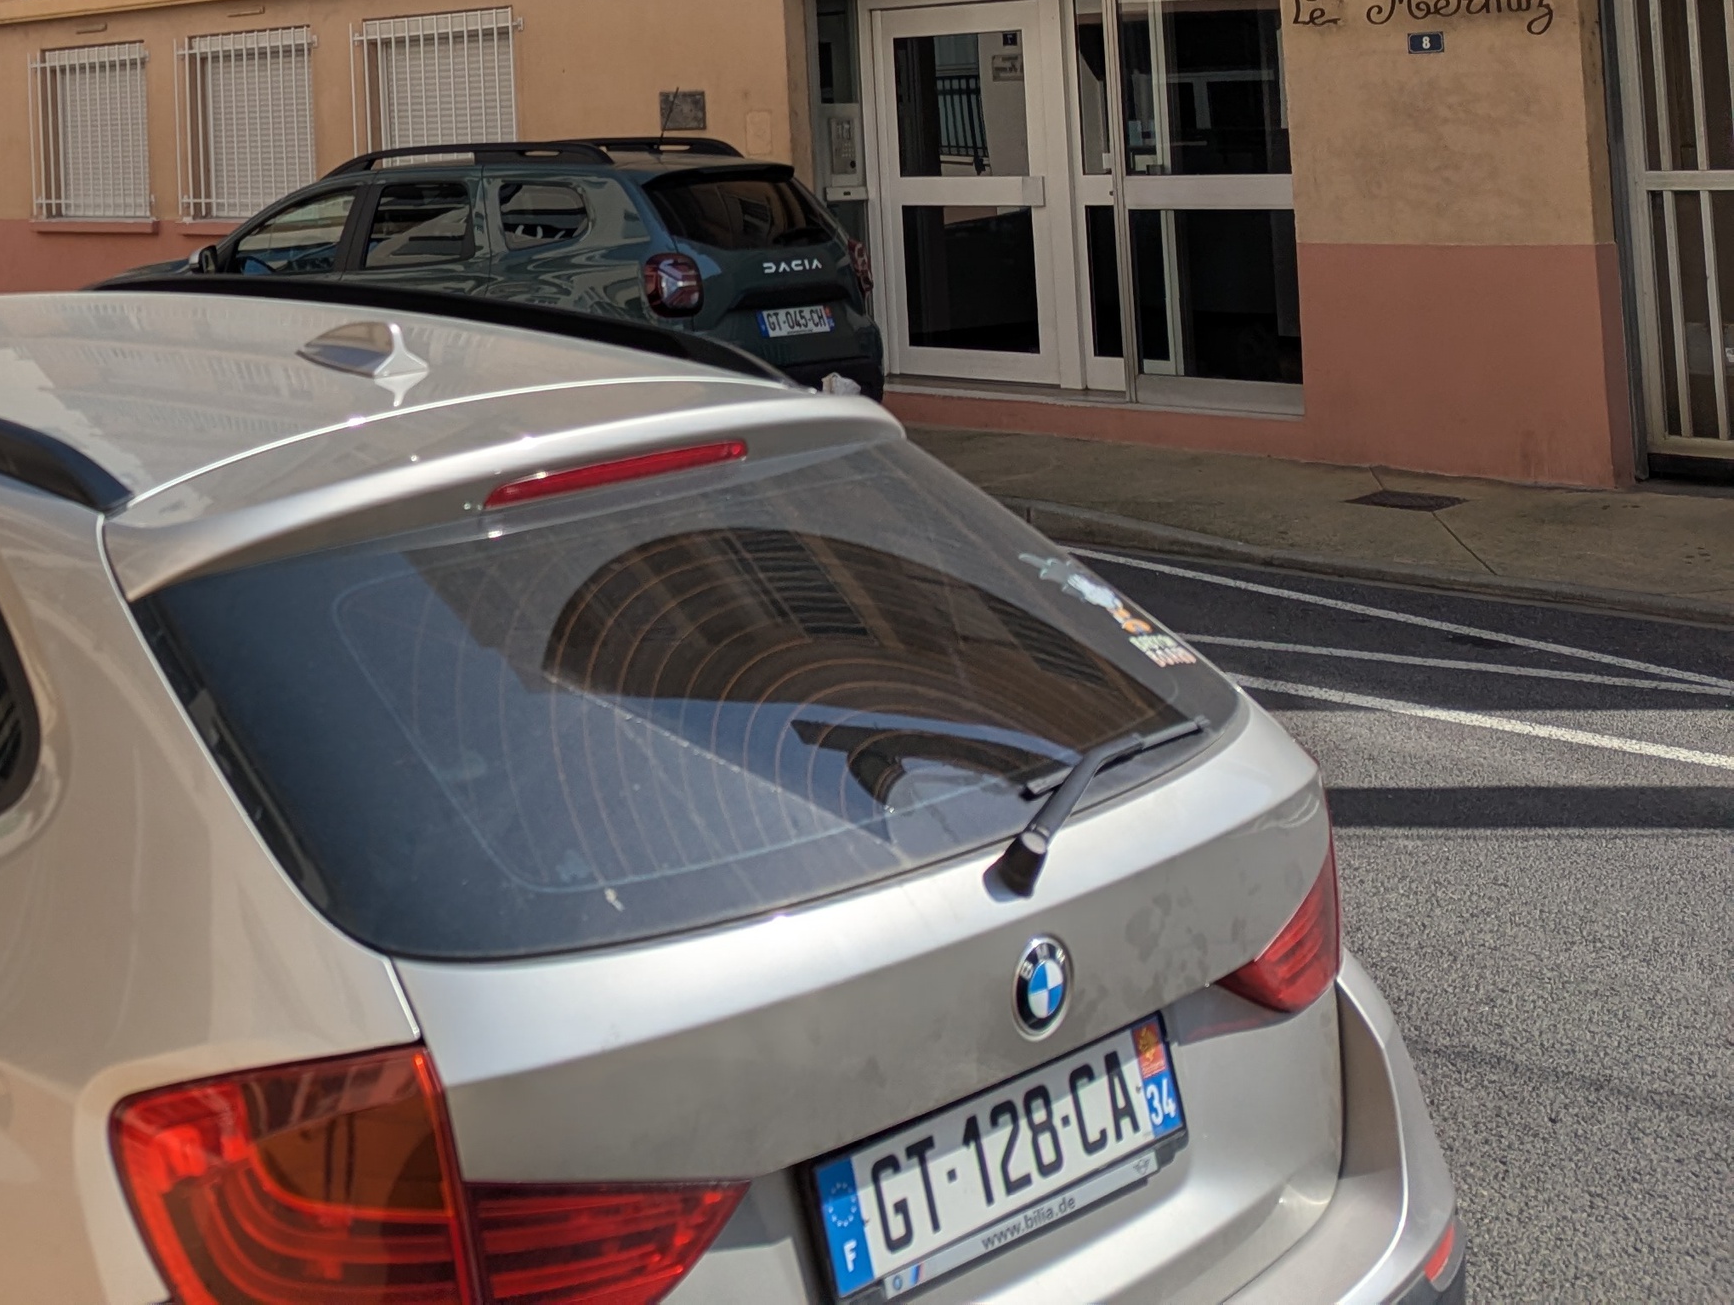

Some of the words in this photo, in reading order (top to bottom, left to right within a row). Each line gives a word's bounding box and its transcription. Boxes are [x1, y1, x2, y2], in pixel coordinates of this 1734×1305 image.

[1421, 36, 1431, 49] 8
[762, 258, 823, 274] DACIA
[1020, 942, 1066, 981] BMW
[1146, 1077, 1176, 1125] 34
[980, 1194, 1077, 1251] www.bilia.de
[843, 1239, 859, 1273] F
